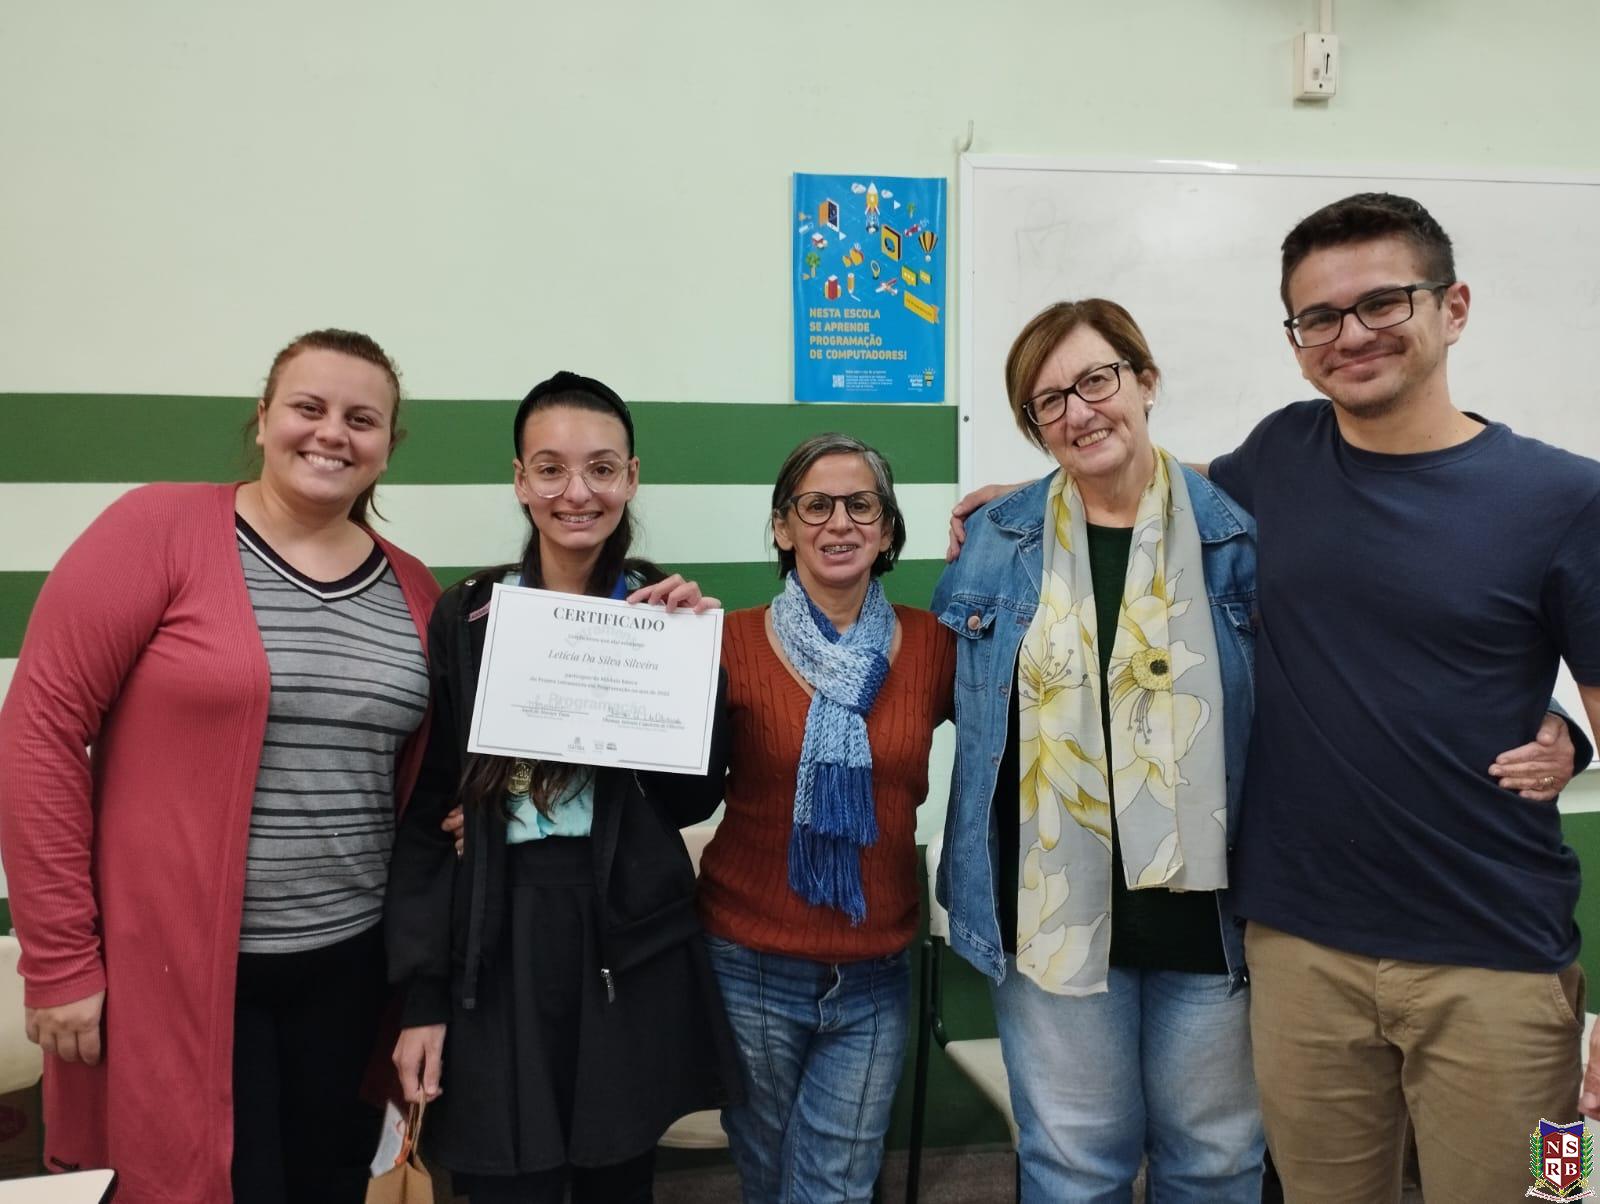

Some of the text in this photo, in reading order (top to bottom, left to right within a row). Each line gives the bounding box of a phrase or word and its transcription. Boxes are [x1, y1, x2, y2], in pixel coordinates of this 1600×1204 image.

[809, 308, 881, 319] NESTA ESCOLA
[809, 321, 870, 332] SE APRENDE
[809, 334, 882, 348] PROGRAMAÇÃO
[809, 349, 907, 361] DE COMPUTADORES!
[553, 606, 665, 632] CERTIFICADO
[582, 652, 595, 663] Da
[597, 654, 621, 667] Silva
[623, 657, 659, 671] Silveira
